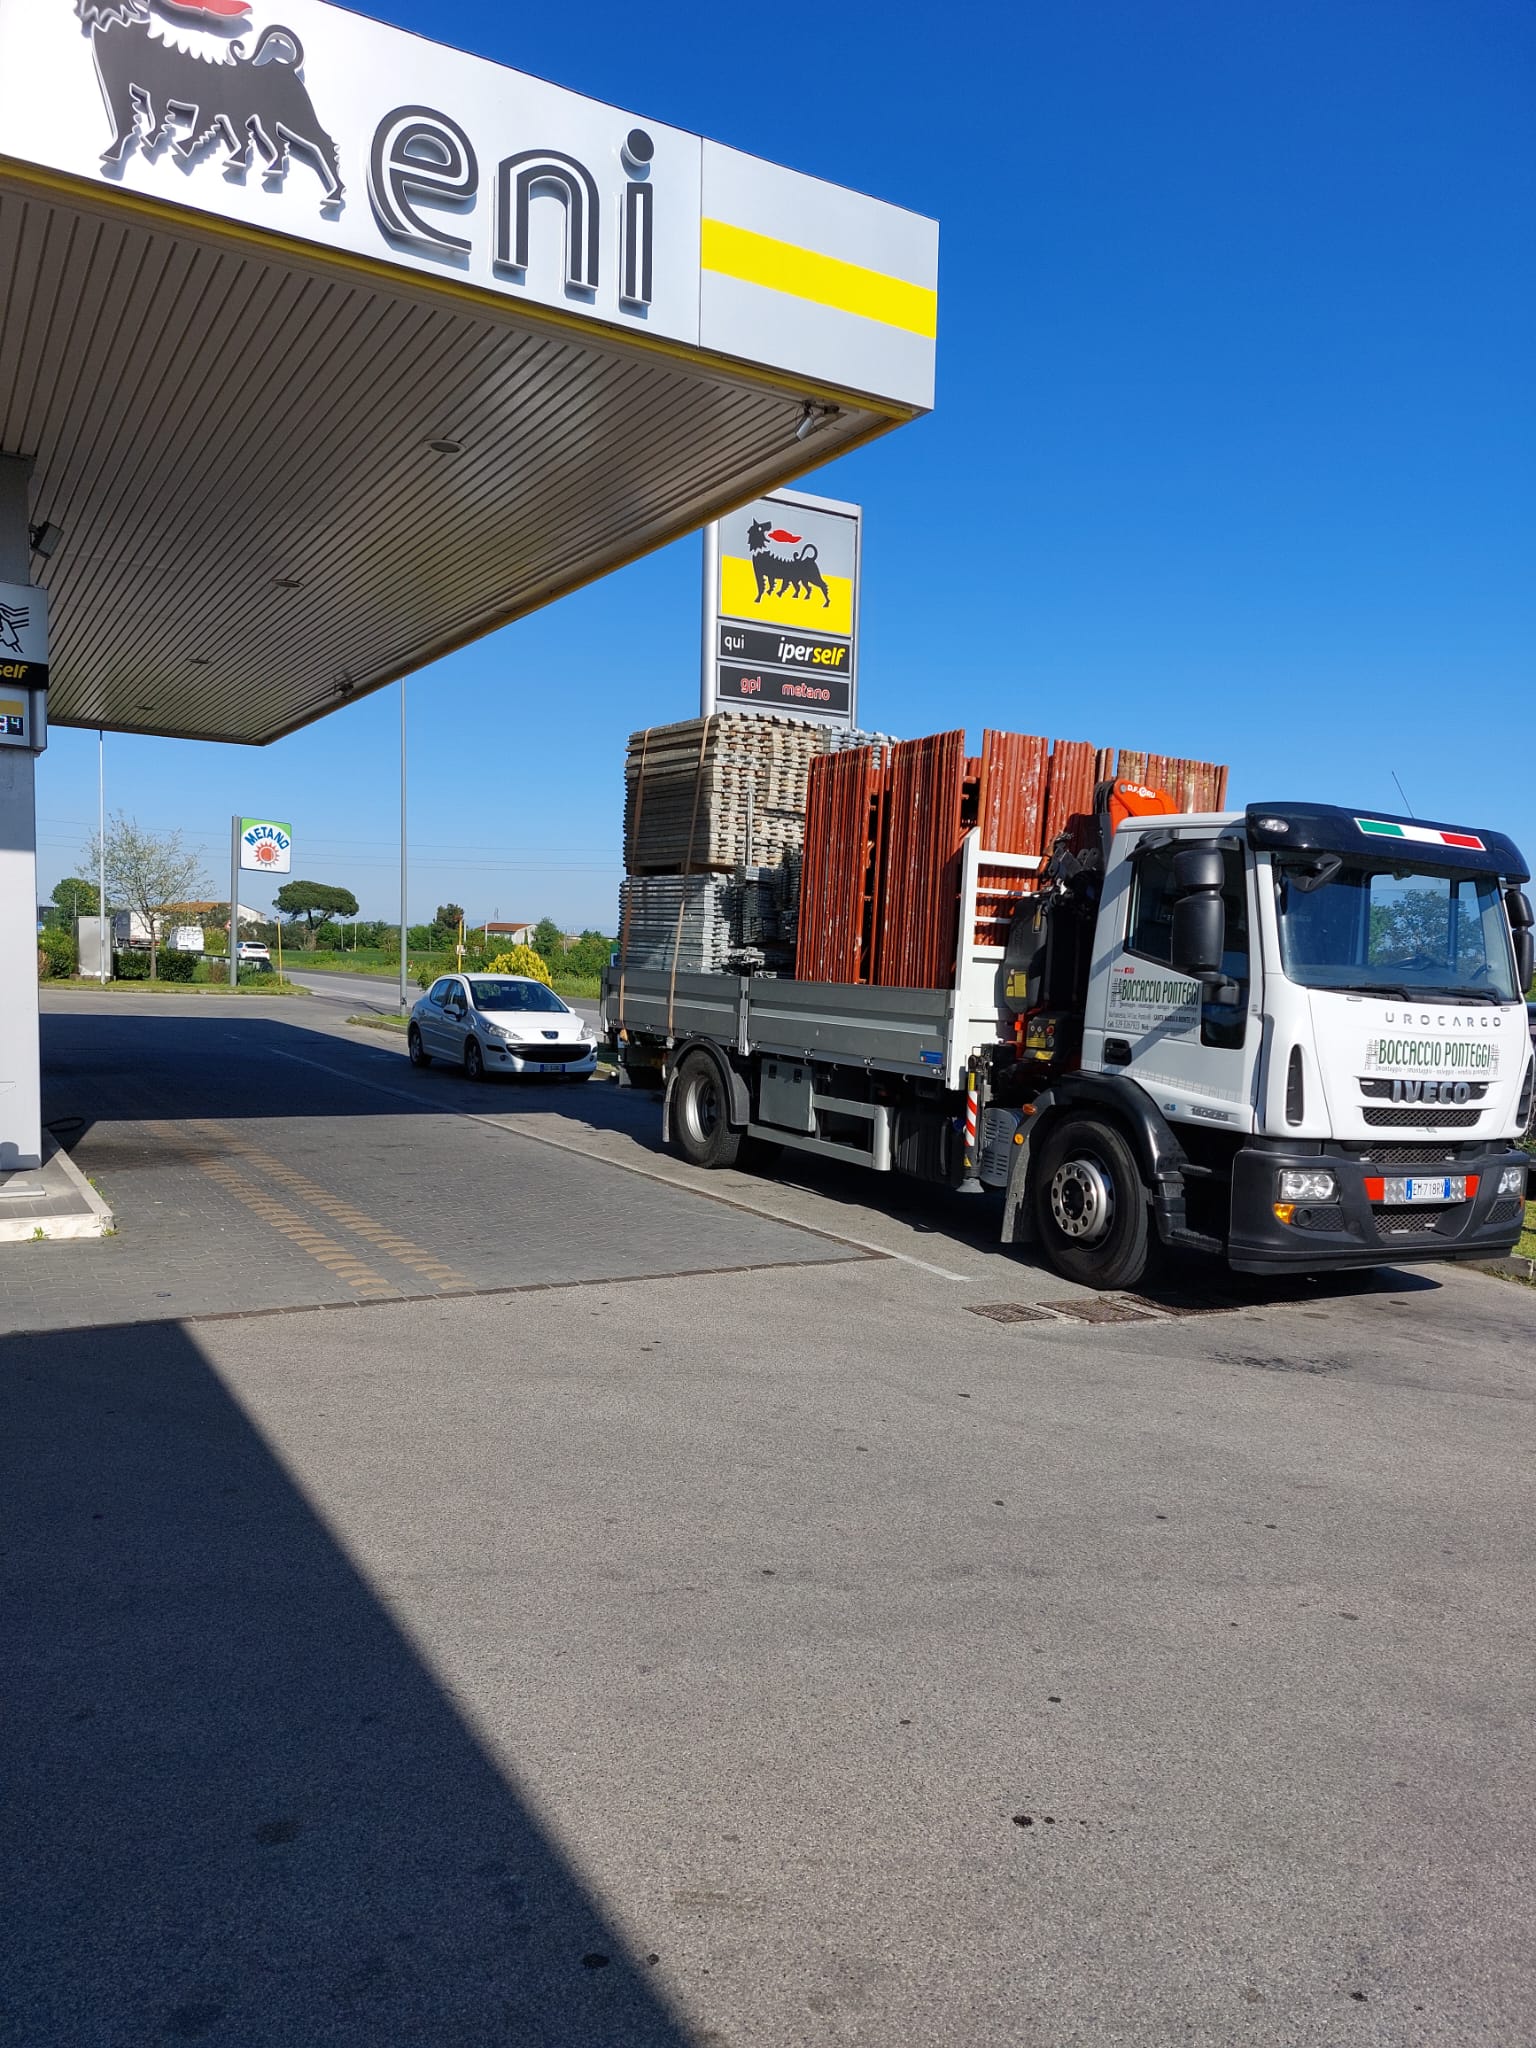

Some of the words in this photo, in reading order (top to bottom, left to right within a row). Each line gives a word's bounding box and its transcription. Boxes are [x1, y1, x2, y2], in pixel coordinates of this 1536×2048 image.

[368, 105, 654, 305] eni
[724, 634, 745, 650] qui
[778, 637, 846, 667] iperself
[741, 676, 762, 694] gpl
[782, 682, 831, 701] metano
[244, 826, 290, 850] METANO
[1121, 979, 1162, 1003] BOCCACCIO
[1162, 980, 1200, 1006] PONTEGGI
[1378, 1038, 1442, 1067] BOCCACCIO
[1444, 1041, 1492, 1069] PONTEGGI
[1392, 1079, 1471, 1105] IVECO
